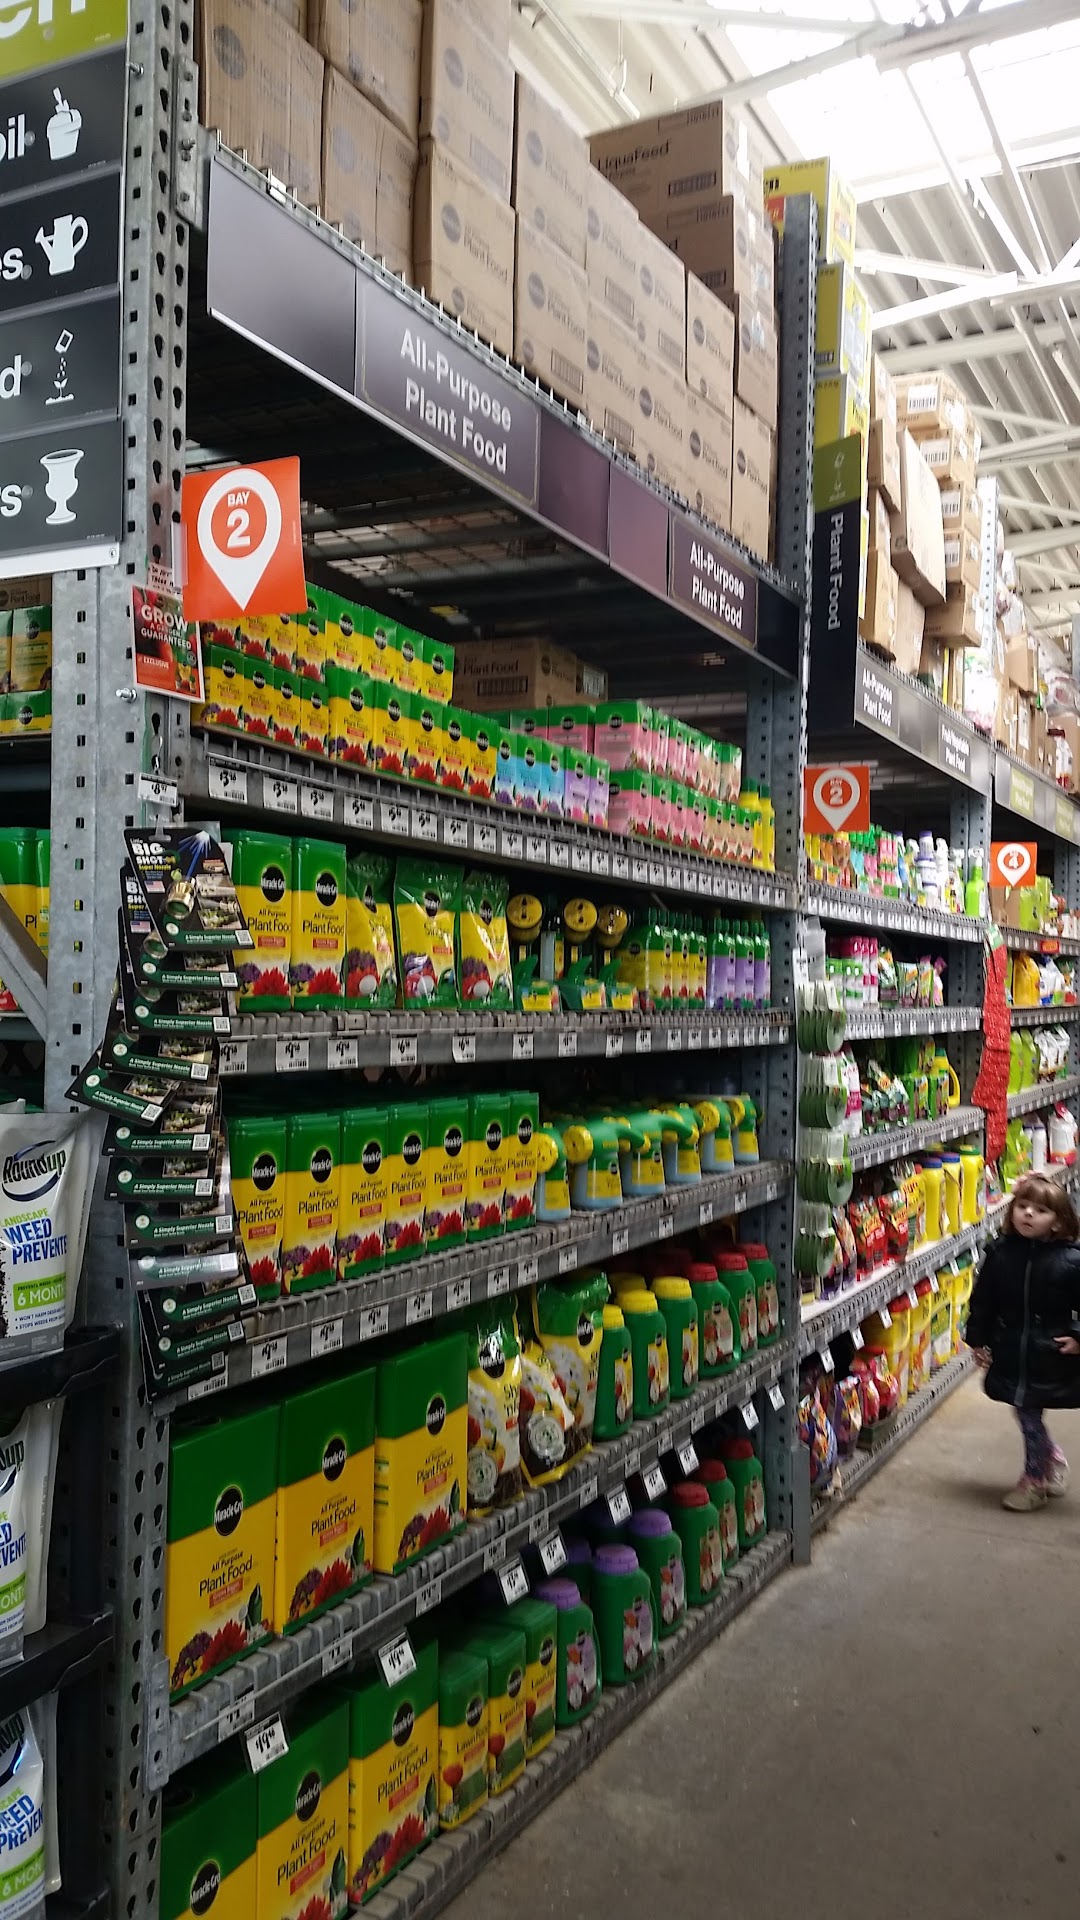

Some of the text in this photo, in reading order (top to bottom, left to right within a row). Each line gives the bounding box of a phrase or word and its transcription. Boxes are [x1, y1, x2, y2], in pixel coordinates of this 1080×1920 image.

[400, 328, 512, 432] All-Purpose
[405, 377, 508, 475] Plant Food
[226, 491, 250, 507] BAY
[226, 509, 251, 549] 2
[689, 541, 745, 600] All-Purpose
[828, 511, 845, 632] Plant Food
[692, 575, 744, 631] Plant Food
[141, 604, 189, 633] GROW
[141, 627, 192, 651] GUARANTEED
[143, 656, 170, 669] EXCLUSIVE
[862, 668, 893, 704] All-Purpose
[864, 694, 892, 727] Plant Food
[829, 786, 844, 804] 2
[131, 842, 164, 856] BIG
[136, 855, 165, 865] SHOT
[1008, 854, 1019, 870] 4
[247, 917, 272, 932] Plant
[258, 908, 287, 920] All Purpose
[313, 911, 339, 923] All Purpose
[302, 920, 326, 933] Plant
[3, 1150, 66, 1184] Roundup
[433, 1168, 468, 1184] Plant Food
[156, 1183, 178, 1191] Superior
[351, 1185, 388, 1205] Plant Food
[391, 1176, 427, 1194] Plant Food
[250, 1197, 278, 1209] All Purpose
[298, 1196, 339, 1215] Plant Food
[238, 1205, 284, 1224] Plant Food
[3, 1217, 53, 1245] WEED
[17, 1292, 26, 1306] 6
[416, 1454, 454, 1485] Plant Food
[320, 1495, 348, 1515] All Purpose
[311, 1499, 356, 1536] Plant Food
[211, 1551, 244, 1574] All Purpose
[199, 1555, 253, 1598] Plant Food
[377, 1748, 428, 1802] Plant Food
[290, 1818, 326, 1854] All Purpose
[277, 1818, 337, 1887] Plant Food
